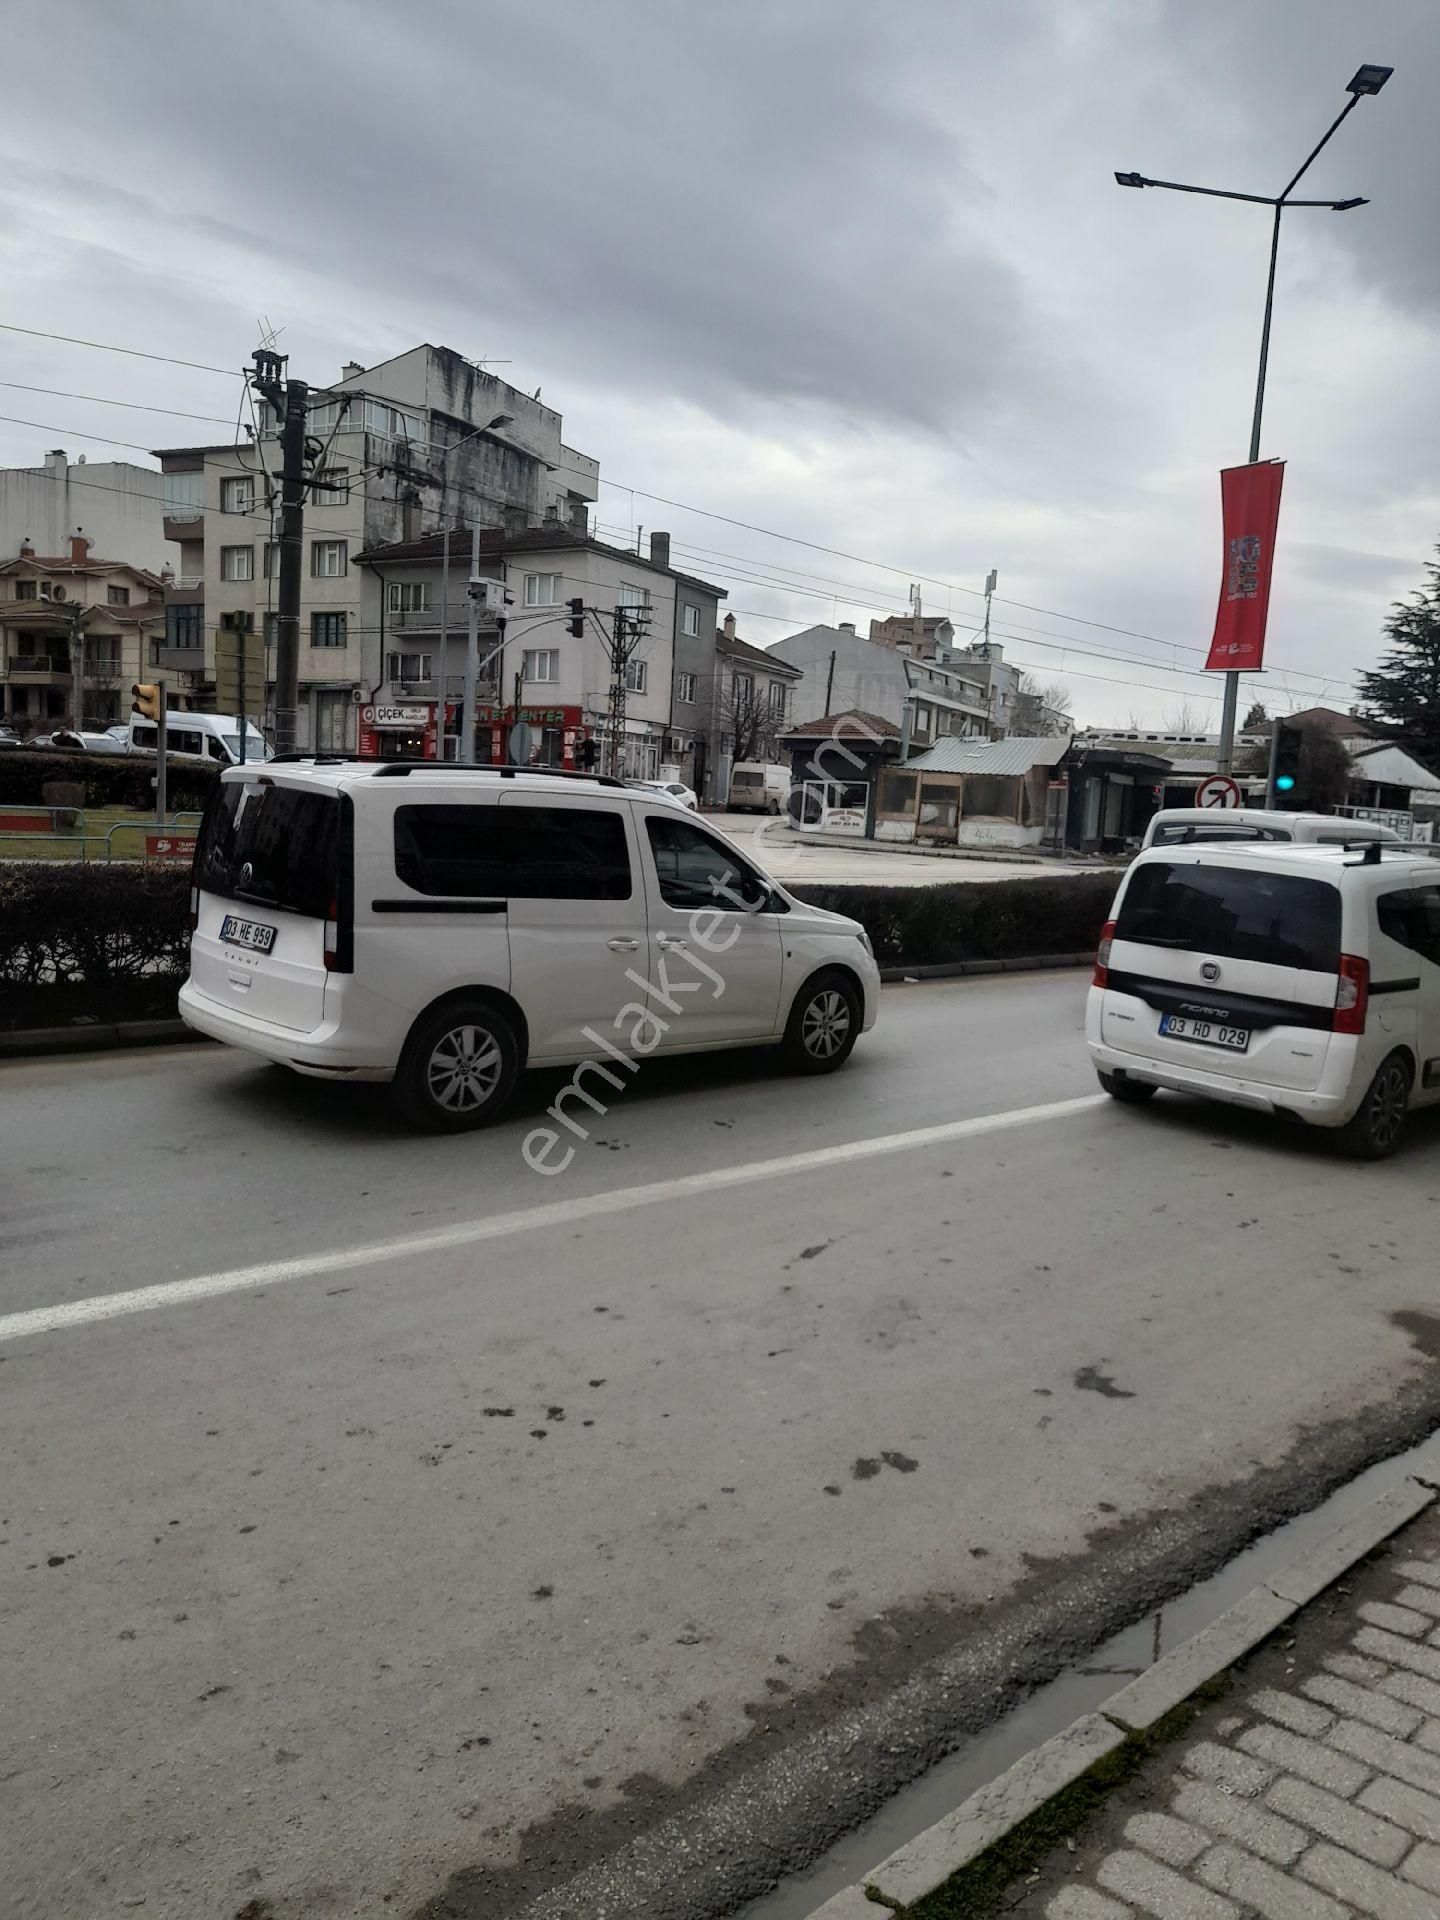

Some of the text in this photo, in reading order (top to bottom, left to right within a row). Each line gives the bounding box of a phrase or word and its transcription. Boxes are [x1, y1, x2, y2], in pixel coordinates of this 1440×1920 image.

[226, 919, 271, 946] 03 HE 959
[1168, 1017, 1246, 1045] 03 HD 029
